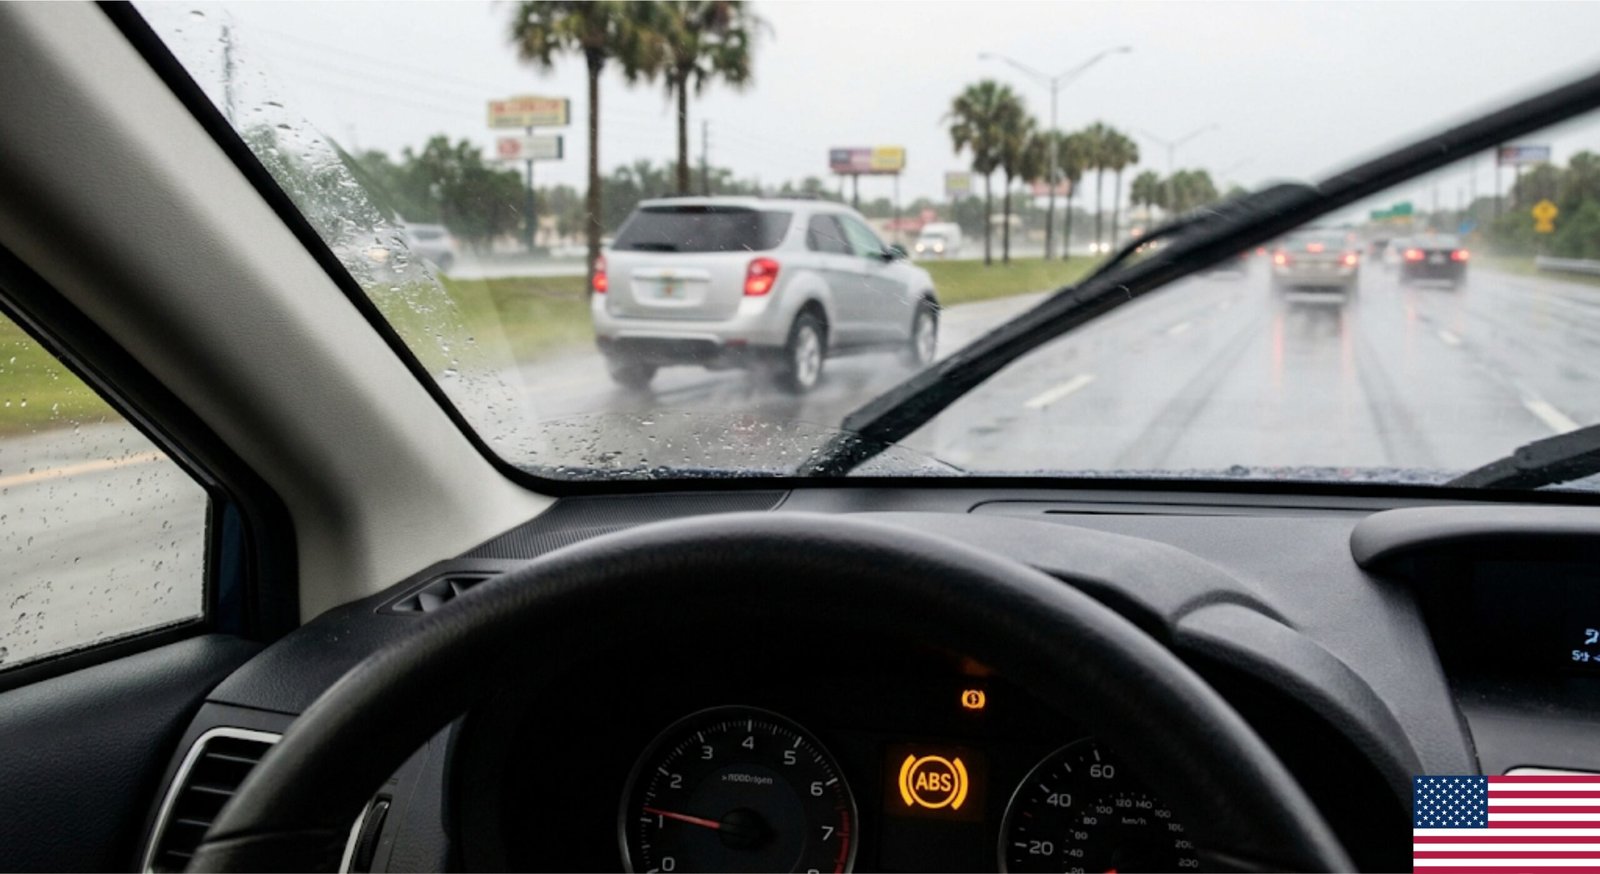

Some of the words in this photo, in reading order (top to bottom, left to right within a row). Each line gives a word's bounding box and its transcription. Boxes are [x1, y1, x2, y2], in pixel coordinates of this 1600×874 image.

[741, 736, 754, 749] 4
[701, 746, 714, 760] 3
[783, 750, 796, 766] 5
[1089, 764, 1115, 779] 60
[669, 773, 682, 789] 2
[810, 781, 824, 796] 6
[915, 771, 952, 792] ABS
[1046, 793, 1072, 808] 40
[1115, 798, 1133, 808] 120
[1135, 800, 1153, 810] 140
[1095, 805, 1114, 815] 100
[658, 814, 664, 829] 1
[1121, 816, 1147, 826] km/h
[821, 825, 835, 841] 7
[1028, 841, 1055, 856] 20
[1069, 848, 1085, 858] 40
[661, 857, 676, 872] 0
